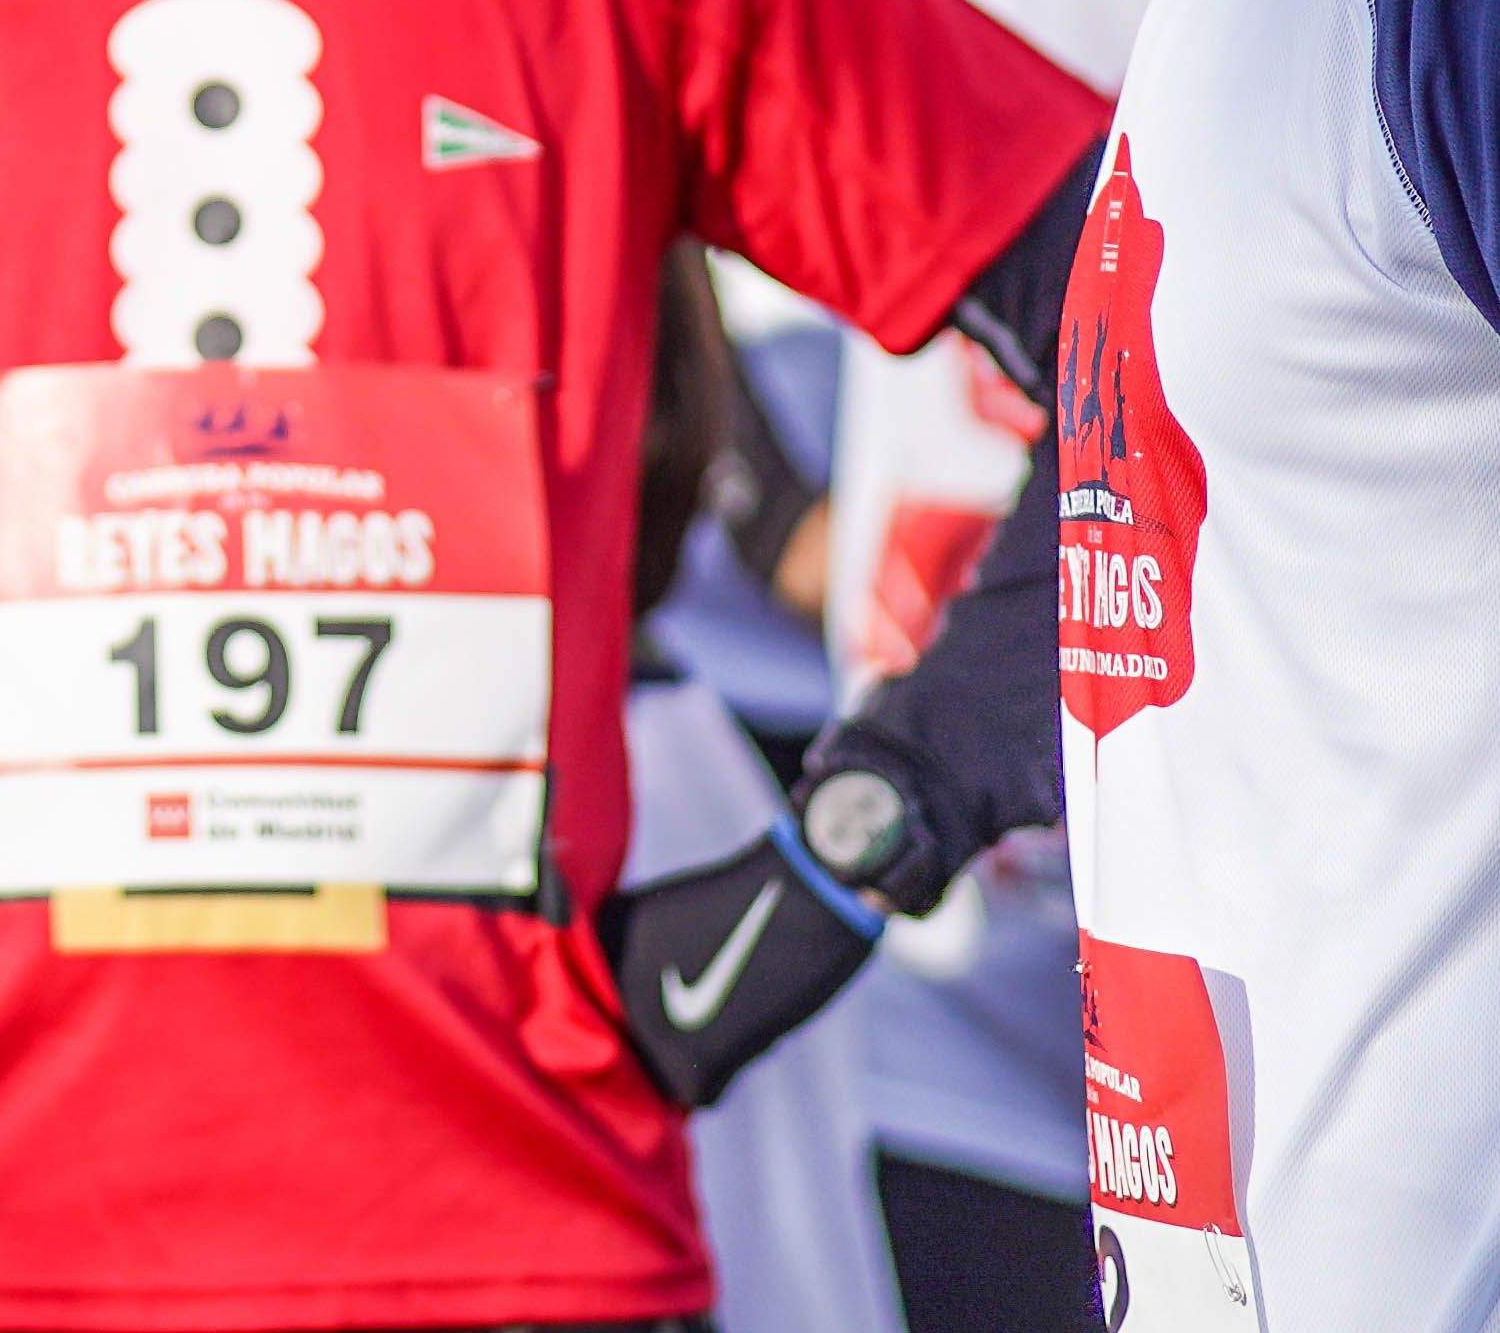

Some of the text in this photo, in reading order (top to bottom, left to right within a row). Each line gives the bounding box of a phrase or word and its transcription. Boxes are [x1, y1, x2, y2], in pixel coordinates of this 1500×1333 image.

[56, 510, 435, 589] REYES MAGOS
[109, 614, 394, 736] 197
[1093, 1111, 1178, 1207] MAGOS
